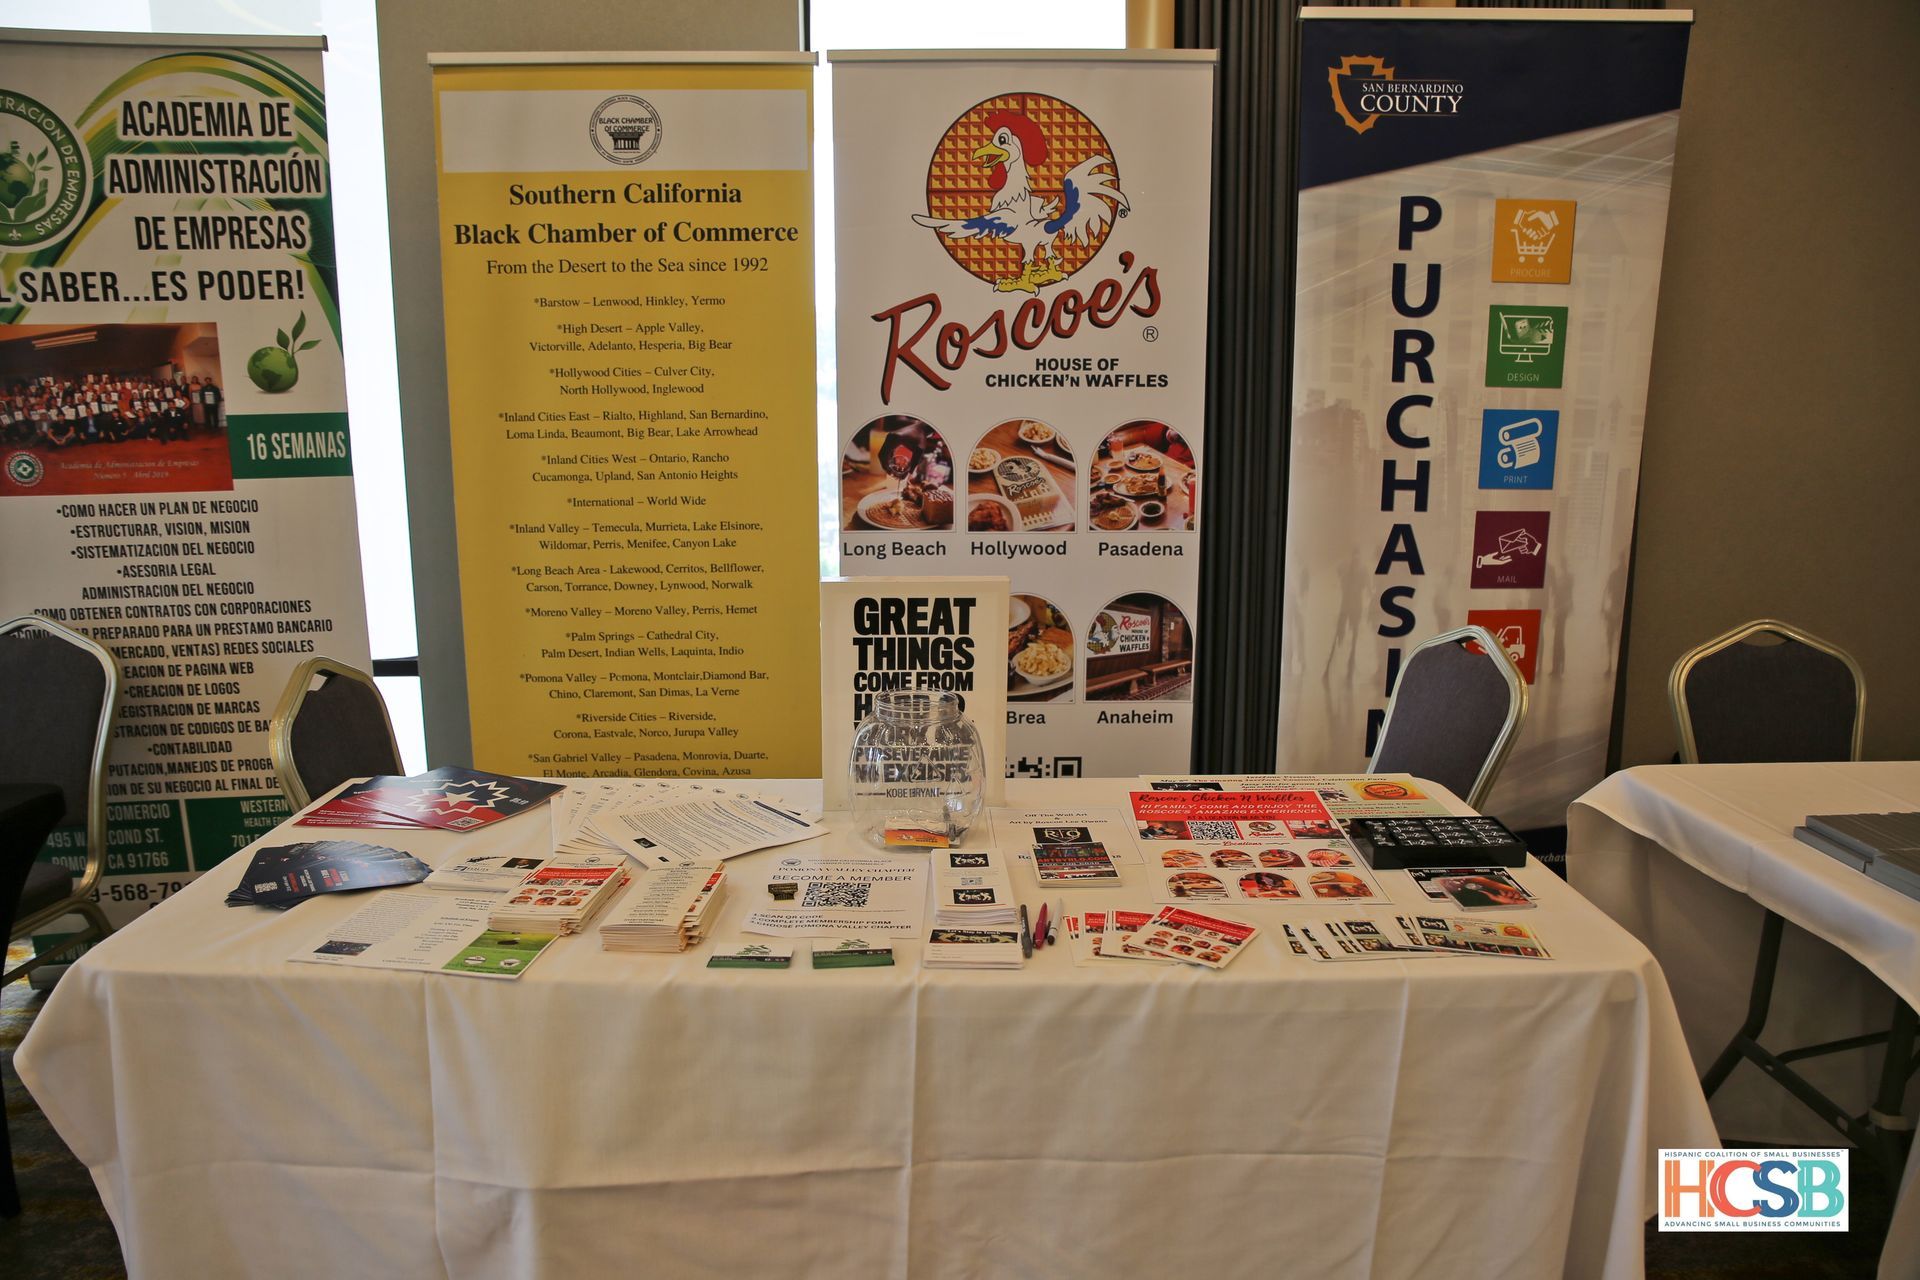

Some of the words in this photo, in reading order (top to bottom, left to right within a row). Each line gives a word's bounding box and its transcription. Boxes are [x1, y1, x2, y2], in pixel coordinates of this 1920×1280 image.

[1362, 82, 1384, 94] SAN
[1387, 83, 1464, 95] BERNARDINO
[1359, 94, 1464, 114] COUNTY
[122, 100, 254, 137] ACADEMIA
[259, 102, 295, 137] DE
[599, 117, 620, 125] BLACK
[621, 117, 653, 125] CHAMBER
[613, 125, 650, 133] COMMERCE
[61, 145, 78, 164] DE
[109, 153, 322, 195] ADMINISTRACIÓN
[509, 183, 617, 206] Southern
[623, 182, 742, 204] California
[34, 170, 81, 236] EMPRESAS
[134, 216, 169, 251] DE
[173, 215, 309, 250] EMPRESAS
[454, 223, 521, 245] Black
[528, 222, 637, 245] Chamber
[643, 222, 668, 243] of
[673, 221, 799, 243] Commerce
[487, 260, 528, 275] From
[531, 259, 554, 274] the
[559, 259, 607, 274] Desert
[611, 260, 626, 273] to
[630, 258, 653, 273] the
[658, 258, 685, 273] Sea
[688, 258, 727, 272] since
[734, 257, 769, 272] 1992
[1510, 267, 1551, 278] PROCURE
[199, 269, 305, 300] PODER!
[871, 251, 1162, 406] Roscoe's
[529, 341, 585, 352] Victorville,
[587, 340, 636, 351] Adelanto,
[639, 340, 686, 353] Hesperia,
[688, 339, 706, 353] Big
[708, 339, 733, 350] Bear
[1035, 357, 1093, 372] HOUSE
[1097, 358, 1120, 372] OF
[985, 373, 1080, 388] CHICKEN'N
[1085, 374, 1169, 388] WAFFLES
[1506, 372, 1540, 383] DESIGN
[506, 429, 535, 440] Loma
[537, 428, 569, 440] Linda,
[571, 428, 624, 439] Beaumont,
[626, 427, 645, 440] Big
[647, 427, 674, 438] Bear,
[676, 426, 701, 437] Lake
[703, 426, 759, 437] Arrowhead
[246, 432, 268, 461] 16
[271, 430, 346, 460] SEMANAS
[532, 471, 593, 484] Cucamonga,
[595, 470, 635, 484] Upland,
[636, 470, 656, 481] San
[658, 470, 698, 480] Antonio
[700, 469, 739, 482] Heights
[1503, 475, 1528, 484] PRINT
[98, 502, 138, 517] HACER
[139, 502, 156, 516] UN
[158, 501, 190, 516] PLAN
[191, 500, 208, 515] DE
[210, 499, 259, 514] NEGOCIO
[164, 521, 207, 536] VISION,
[209, 520, 251, 535] MISION
[538, 540, 591, 550] Wildomar,
[593, 539, 625, 550] Perris,
[627, 538, 670, 549] Menifee,
[672, 538, 710, 551] Canyon
[712, 537, 737, 548] Lake
[843, 542, 887, 560] Long
[892, 540, 946, 556] Beach
[971, 540, 1067, 560] Hollywood
[1098, 541, 1184, 557] Pasadena
[1496, 575, 1517, 584] MAIL
[82, 584, 179, 600] ADMINISTRACION
[181, 583, 204, 597] DEL
[206, 581, 255, 596] NEGOCIO
[853, 597, 977, 636] GREAT
[1120, 634, 1146, 643] CHICKEN
[852, 636, 975, 671] THINGS
[1120, 643, 1149, 653] WAFFLES
[187, 683, 203, 697] DE
[204, 681, 241, 696] LOGOS
[853, 671, 912, 693] COME
[916, 671, 974, 693] FROM
[548, 689, 582, 700] Chino,
[583, 688, 637, 699] Claremont,
[638, 687, 657, 698] San
[659, 687, 693, 697] Dimas,
[695, 687, 709, 697] La
[710, 687, 740, 697] Verne
[1006, 710, 1046, 725] Brea
[1096, 709, 1173, 724] Anaheim
[1139, 793, 1187, 802] Roscoe's
[1191, 793, 1236, 802] Chicken
[108, 803, 170, 821] COMERCIO
[240, 800, 288, 813] WESTERN
[108, 854, 125, 870] CA
[127, 851, 169, 869] 91766
